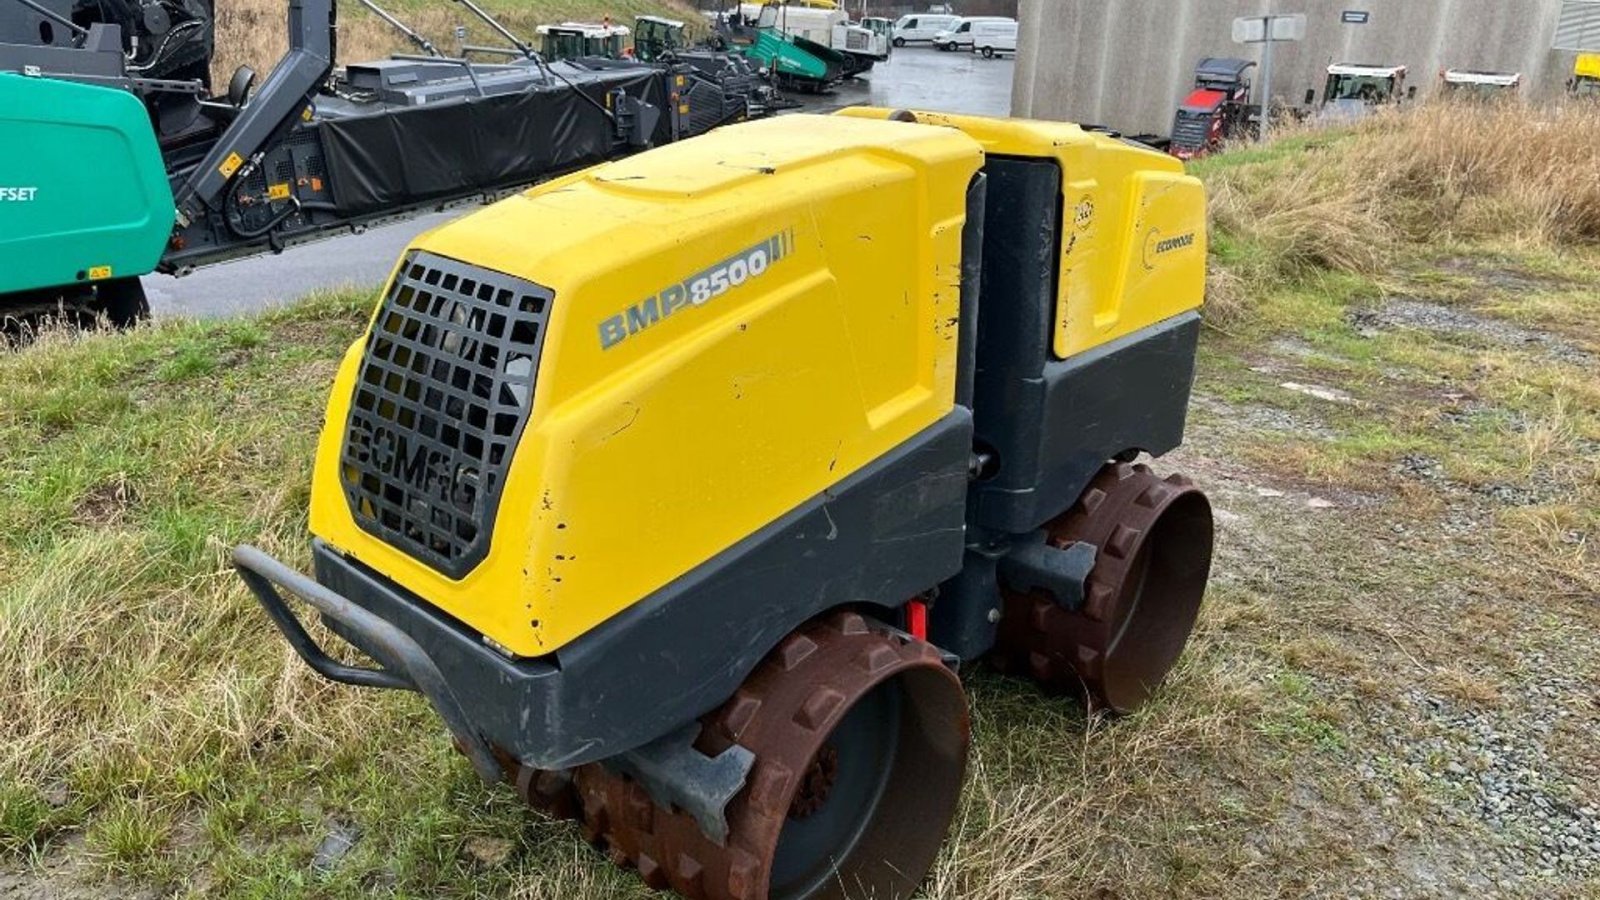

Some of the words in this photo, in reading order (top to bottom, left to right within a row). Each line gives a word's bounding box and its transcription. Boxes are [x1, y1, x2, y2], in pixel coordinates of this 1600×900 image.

[1156, 233, 1194, 253] ECOMODE
[598, 282, 687, 350] BMP
[690, 250, 767, 305] 8500
[348, 415, 479, 515] BOMAG
